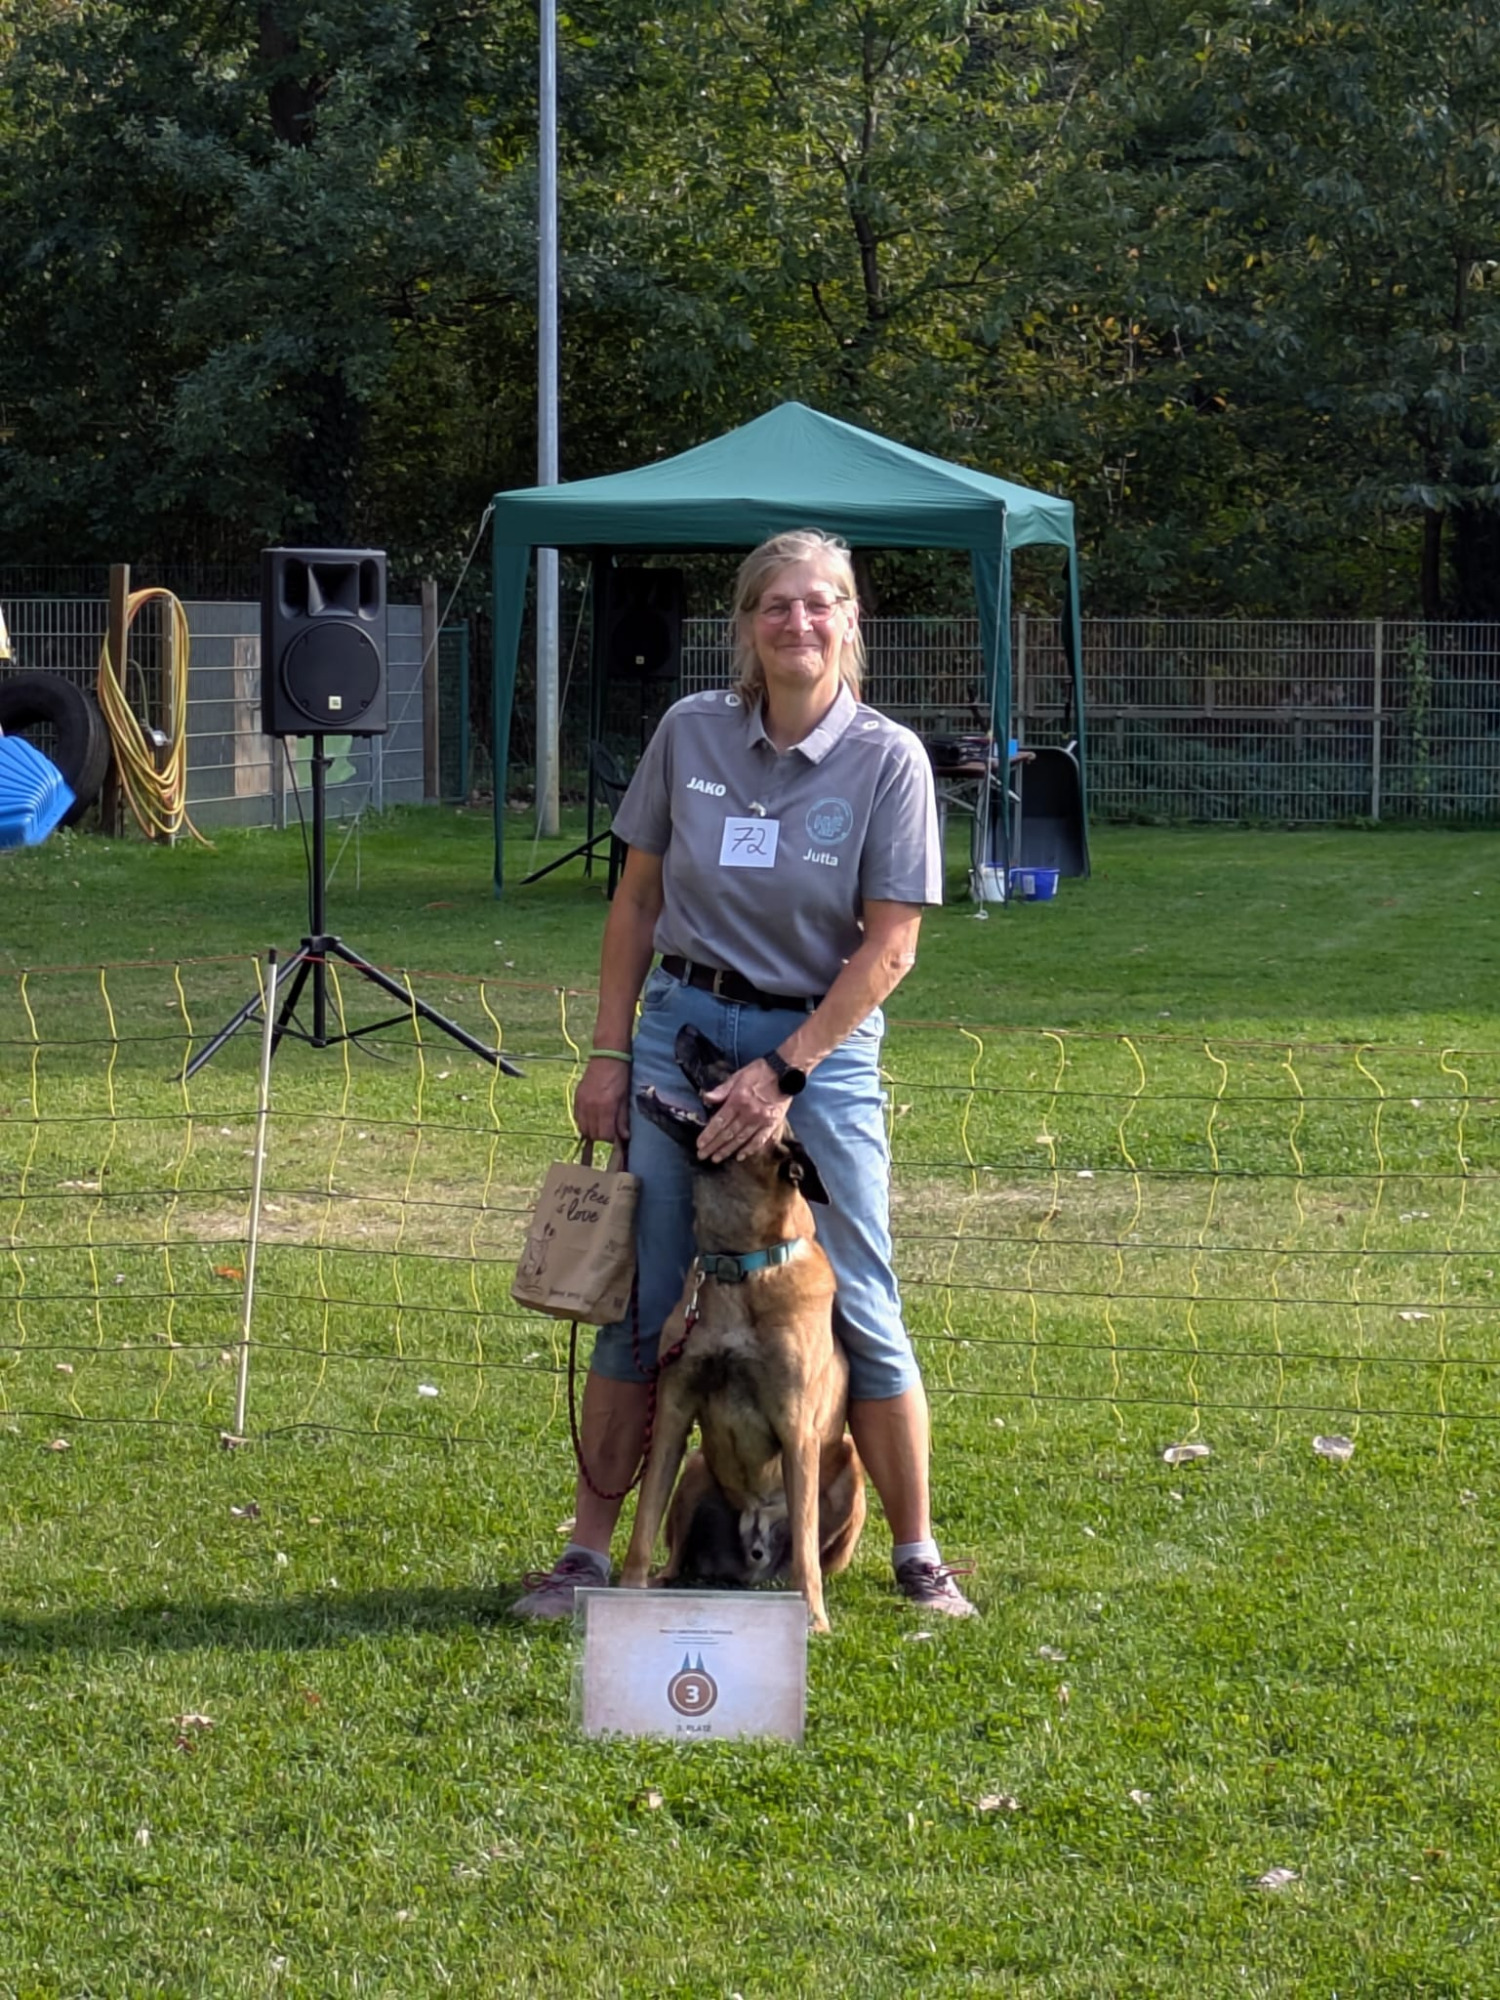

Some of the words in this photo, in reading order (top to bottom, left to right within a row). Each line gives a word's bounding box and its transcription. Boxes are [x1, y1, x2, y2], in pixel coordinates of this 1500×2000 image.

[686, 777, 727, 797] JAKO
[731, 827, 767, 855] 72
[803, 848, 838, 866] Jutta
[567, 1198, 599, 1223] love
[685, 1685, 700, 1703] 3
